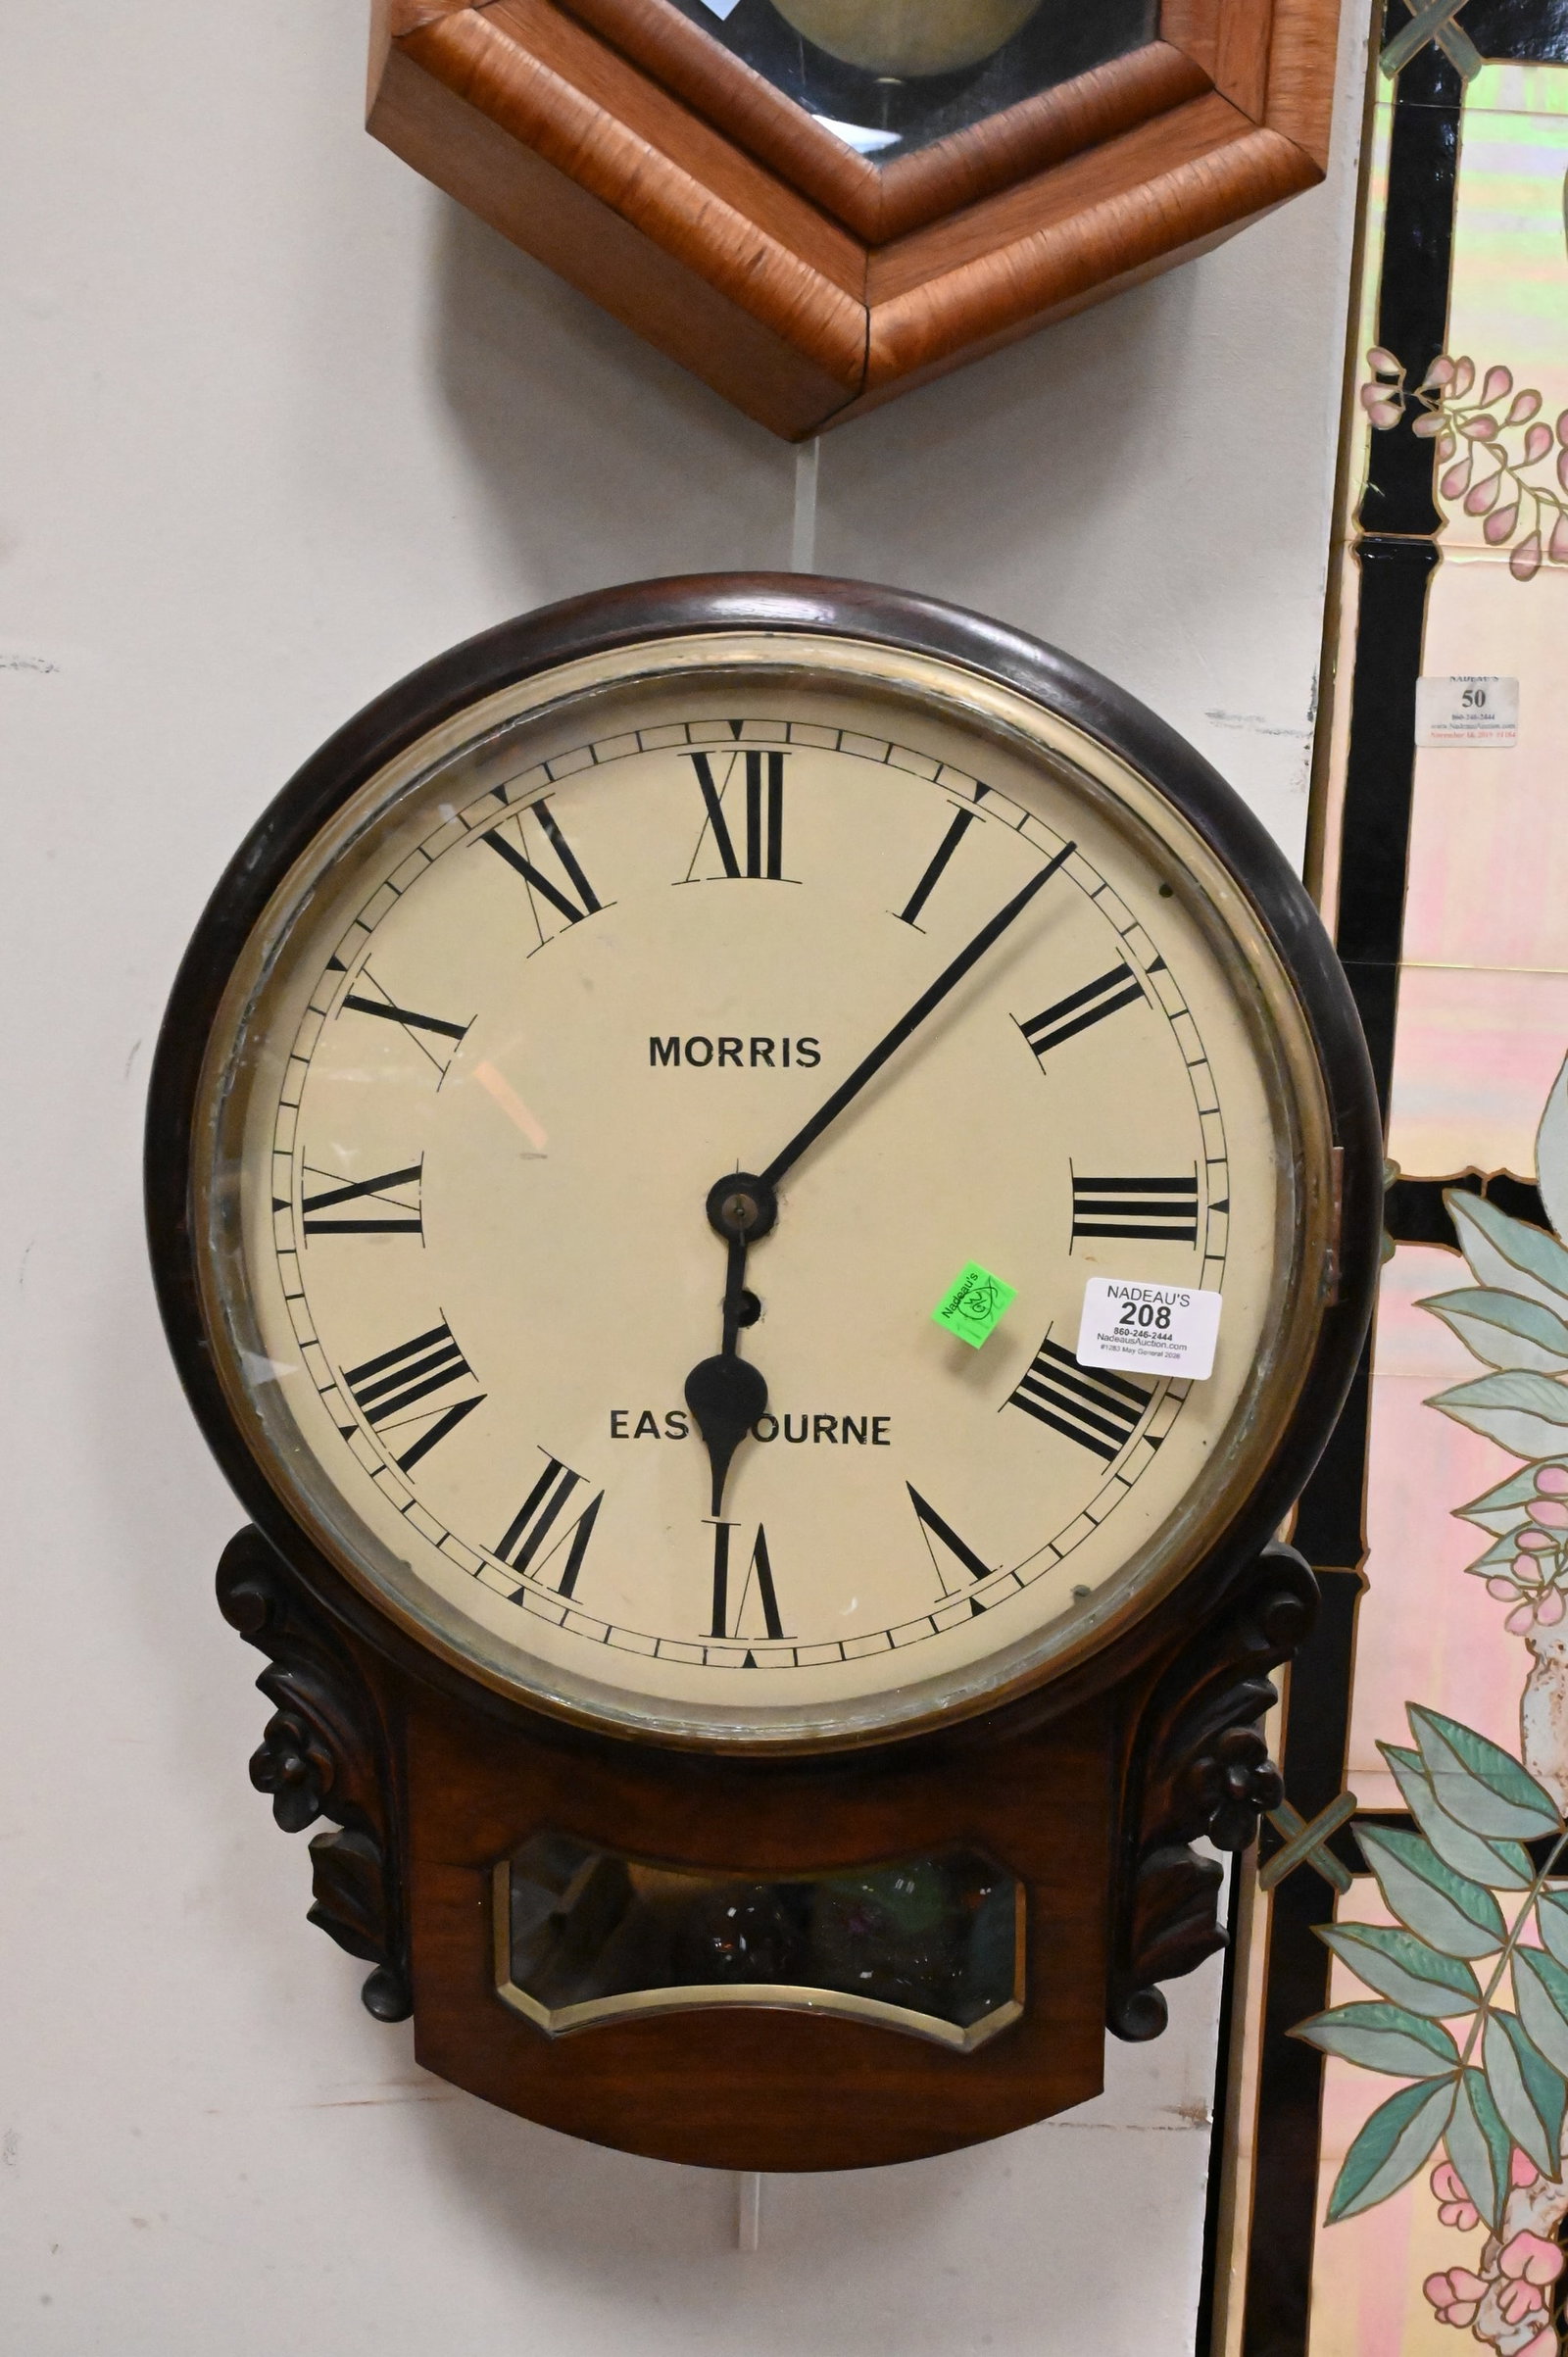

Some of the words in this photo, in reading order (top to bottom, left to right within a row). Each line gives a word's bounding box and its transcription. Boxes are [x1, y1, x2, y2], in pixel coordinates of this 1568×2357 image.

[1461, 689, 1486, 708] 50
[671, 750, 803, 886] XII
[886, 800, 986, 934] I
[466, 792, 618, 958] XI
[335, 953, 478, 1093] X
[649, 1036, 821, 1068] MORRIS
[1009, 947, 1153, 1075] II
[302, 1146, 425, 1250] IX
[1069, 1156, 1199, 1255] III
[941, 1273, 979, 1319] Nadeau's
[1097, 1333, 1187, 1350] NadeausAuction.com
[1107, 1286, 1191, 1307] NADEAU'S
[1113, 1327, 1173, 1341] 860-246-2444
[1119, 1301, 1171, 1329] 208
[338, 1306, 488, 1485] VIII
[1121, 1347, 1136, 1355] May
[611, 1409, 891, 1446] EASOURNE
[479, 1446, 605, 1605] VII
[906, 1481, 1004, 1603] V
[699, 1520, 798, 1640] VI
